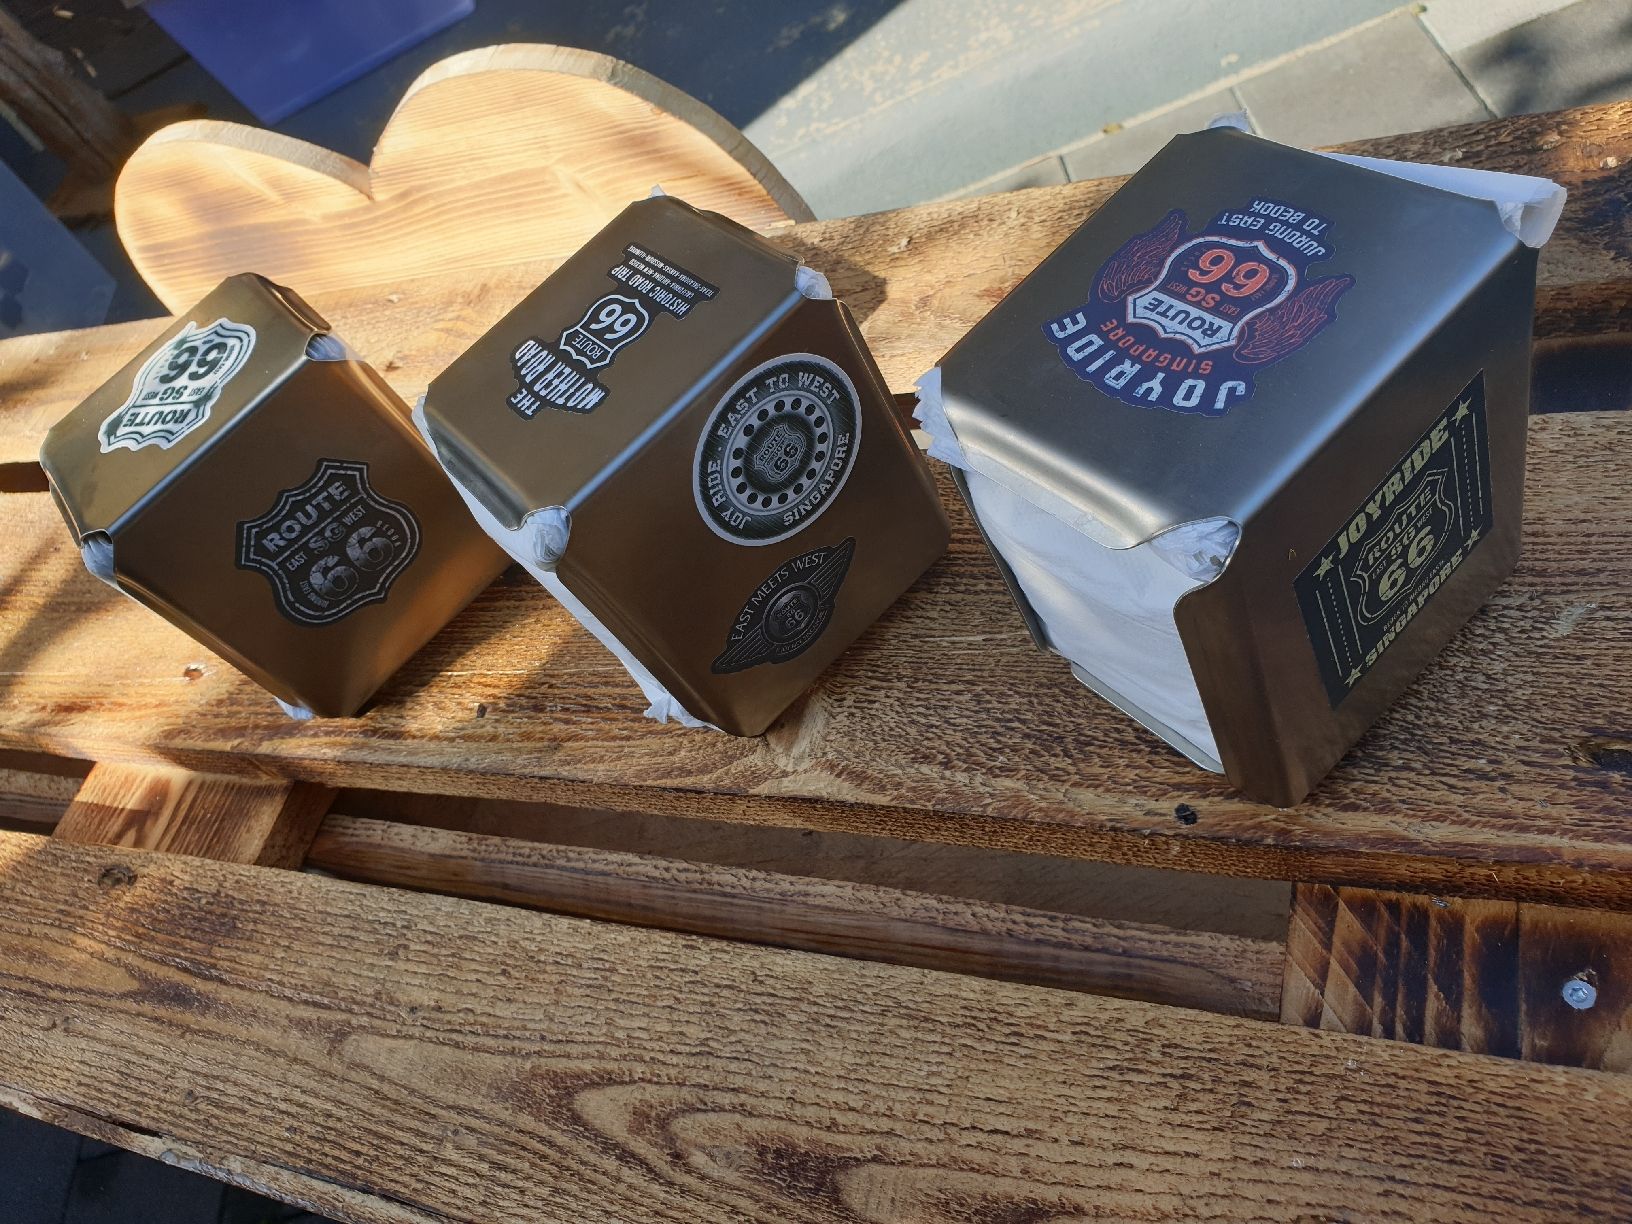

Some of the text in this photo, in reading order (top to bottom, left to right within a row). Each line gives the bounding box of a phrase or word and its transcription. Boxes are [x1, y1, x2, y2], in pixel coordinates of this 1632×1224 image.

[1217, 211, 1326, 257] JURONG EAST
[1249, 199, 1328, 235] TO BEDOK
[611, 265, 690, 315] HISTORIC ROAD TRIP
[1187, 248, 1270, 297] 66
[589, 304, 637, 339] 66
[1141, 297, 1223, 339] ROUTE
[1166, 281, 1240, 316] EAST SG WEST
[159, 342, 227, 384] 66
[572, 334, 603, 359] ROUTE
[1051, 311, 1246, 410] JOYRIDE
[1099, 318, 1212, 375] SINGAPORE
[142, 385, 205, 401] EAST SG WEST
[515, 340, 605, 409] MOTHER ROAD
[123, 409, 191, 427] ROUTE
[510, 388, 540, 416] THE
[708, 371, 840, 530] JOY RIDE EAST TO WEST
[759, 431, 783, 462] ROUTE
[774, 442, 799, 473] 66
[783, 433, 850, 526] SINGAPORE
[1337, 416, 1450, 558] JOYRIDE
[262, 480, 351, 552] ROUTE
[287, 505, 366, 571] EAST SG WEST
[1368, 485, 1433, 567] ROUTE
[309, 526, 394, 600] 66
[1372, 508, 1434, 581] EAST SG WEST
[1378, 525, 1435, 602] 66
[731, 606, 755, 641] EAST
[752, 569, 789, 606] MEETS
[791, 552, 827, 573] WEST
[785, 610, 804, 629] 66
[1364, 548, 1464, 668] SINGAPORE
